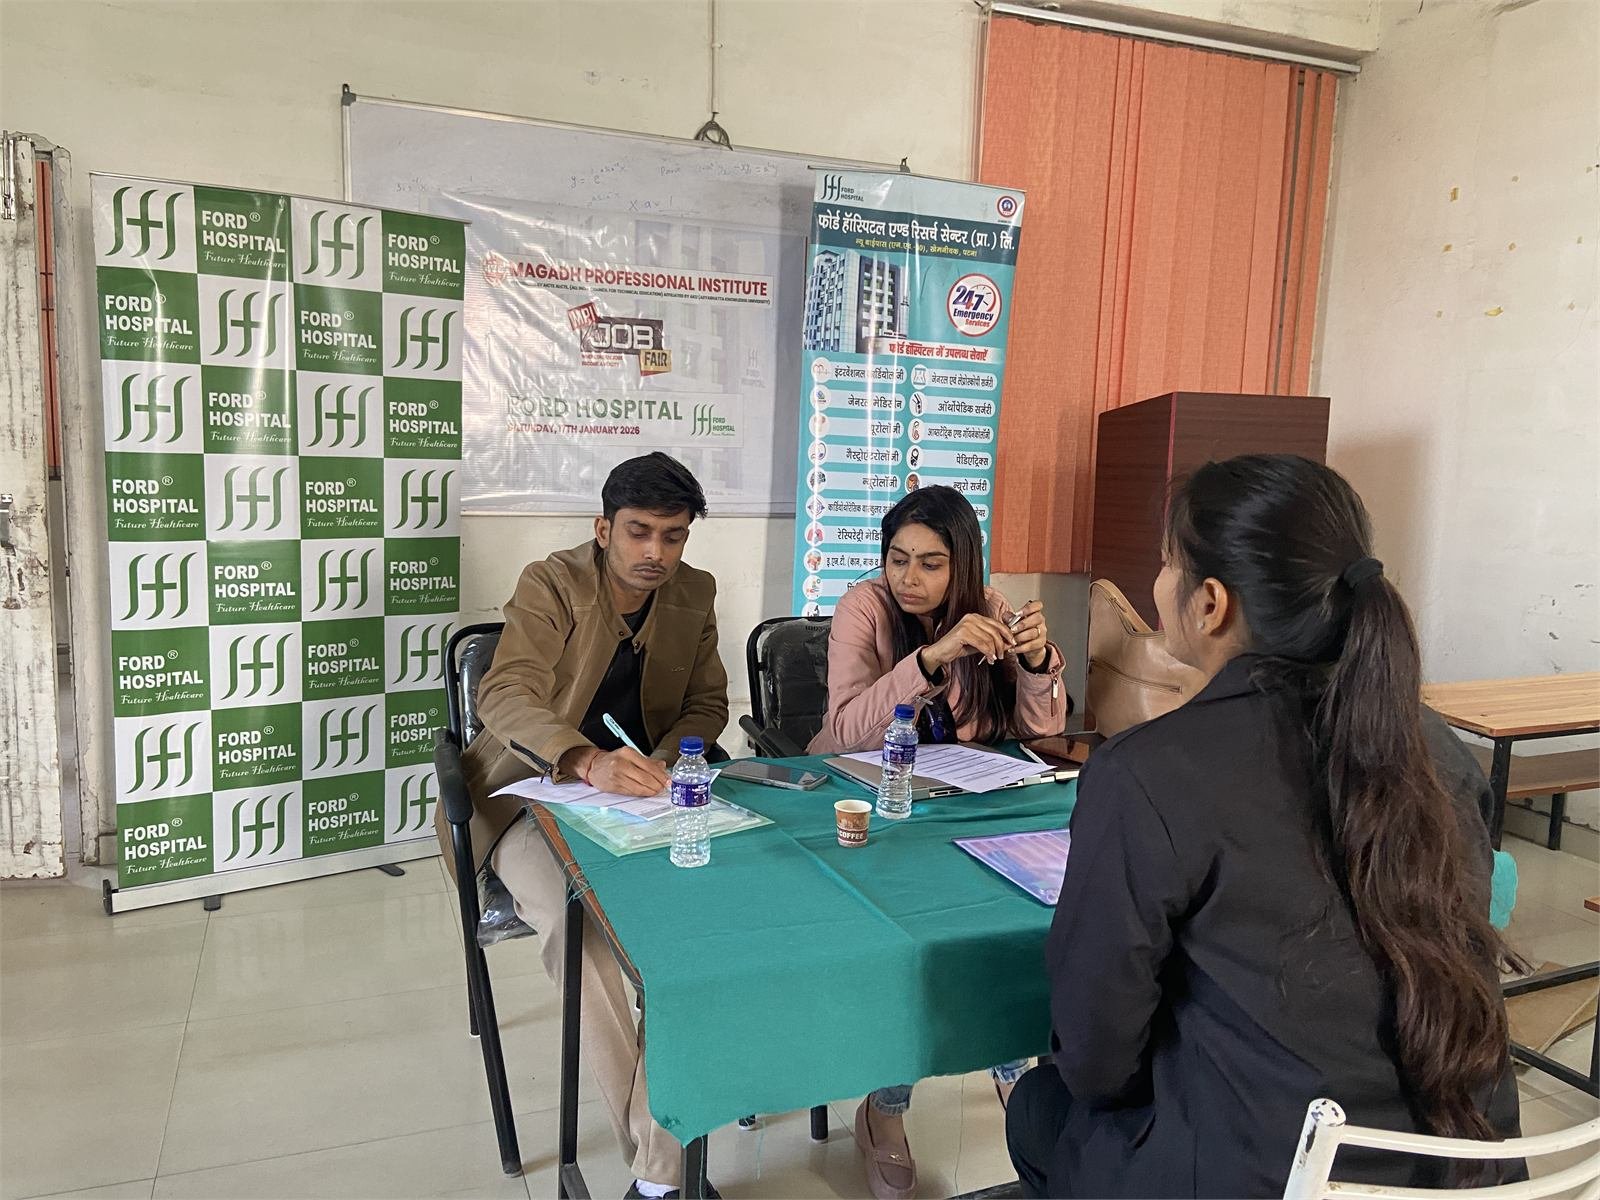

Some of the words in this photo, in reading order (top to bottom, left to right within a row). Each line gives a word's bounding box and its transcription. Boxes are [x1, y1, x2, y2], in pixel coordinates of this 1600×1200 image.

[818, 209, 840, 230] फोर्ड
[842, 212, 886, 235] हॉस्पिटल
[889, 222, 909, 237] एण्ड
[911, 220, 938, 241] रिसर्च
[940, 223, 968, 245] सेन्टर
[1000, 230, 1015, 250] लि.
[202, 230, 285, 253] HOSPITAL
[388, 254, 460, 273] HOSPITAL
[510, 262, 581, 282] MAGADH
[585, 268, 695, 291] PROFESSIONAL
[698, 277, 768, 296] INSTITUTE
[953, 308, 994, 321] Emergency
[106, 315, 192, 335] HOSPITAL
[966, 319, 990, 327] Services
[301, 329, 377, 349] HOSPITAL
[590, 323, 654, 350] JOB
[644, 351, 668, 367] FAIR
[577, 399, 683, 420] HOSPITAL
[975, 403, 992, 415] सर्जरी
[209, 411, 291, 428] HOSPITAL
[389, 419, 458, 435] HOSPITAL
[712, 416, 726, 424] FORD
[578, 425, 618, 435] JANUARY
[620, 426, 640, 435] 2026
[970, 479, 987, 492] सर्जरी
[113, 498, 198, 514] HOSPITAL
[306, 499, 378, 513] HOSPITAL
[114, 518, 147, 529] Future
[150, 517, 199, 529] Healthcare
[307, 518, 334, 527] Future
[336, 517, 378, 527] Healthcare
[215, 582, 295, 598] HOSPITAL
[390, 577, 456, 591] HOSPITAL
[215, 602, 246, 613] Future
[249, 601, 296, 612] Healthcare
[308, 658, 379, 675] HOSPITAL
[120, 670, 203, 690] HOSPITAL
[308, 678, 337, 689] Future
[339, 676, 379, 688] Healthcare
[121, 694, 152, 705] Future
[155, 691, 203, 703] Healthcare
[218, 744, 296, 765] HOSPITAL
[219, 768, 249, 780] Future
[252, 764, 296, 777] Healthcare
[308, 809, 378, 832] HOSPITAL
[309, 834, 337, 846] Future
[339, 828, 379, 840] Healthcare
[839, 830, 863, 840] COFFEE
[125, 836, 207, 861] HOSPITAL
[126, 862, 157, 875] Future
[160, 856, 207, 869] Healthcare
